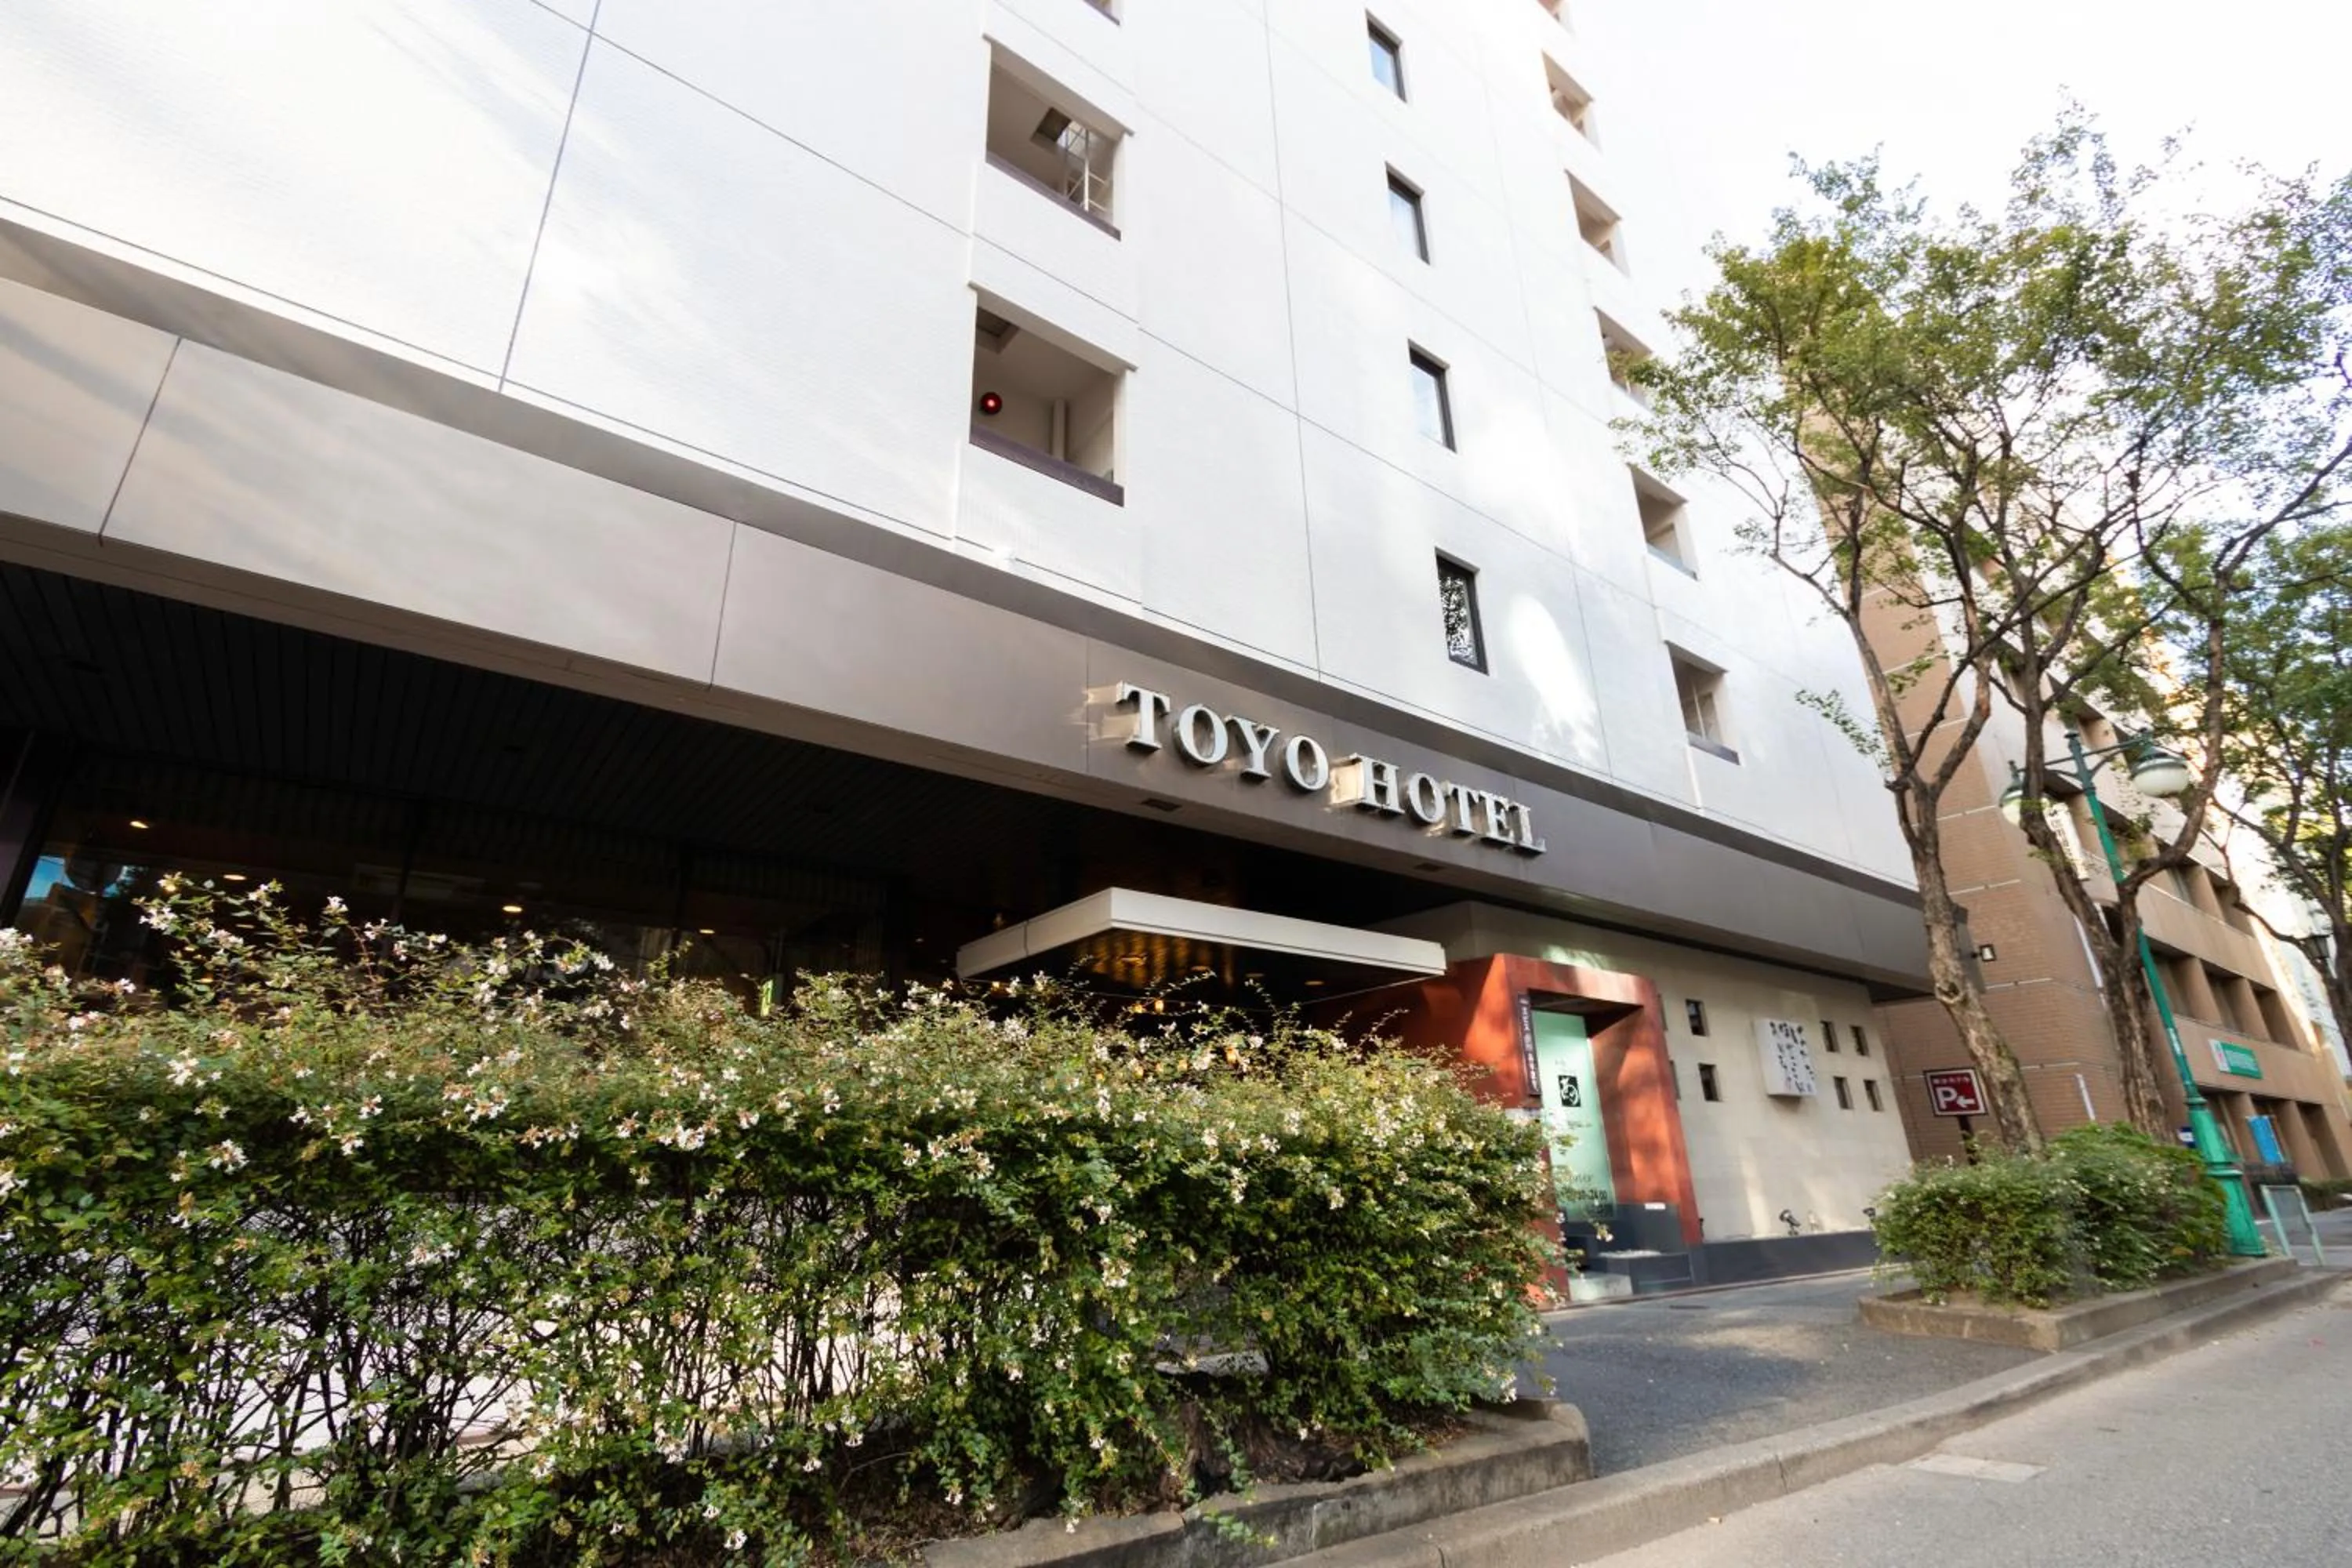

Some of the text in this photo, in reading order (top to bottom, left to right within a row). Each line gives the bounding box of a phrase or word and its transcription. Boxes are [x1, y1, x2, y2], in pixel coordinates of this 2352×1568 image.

[1116, 681, 1547, 855] TOYO HOTEL
[1935, 1087, 1958, 1109] P
